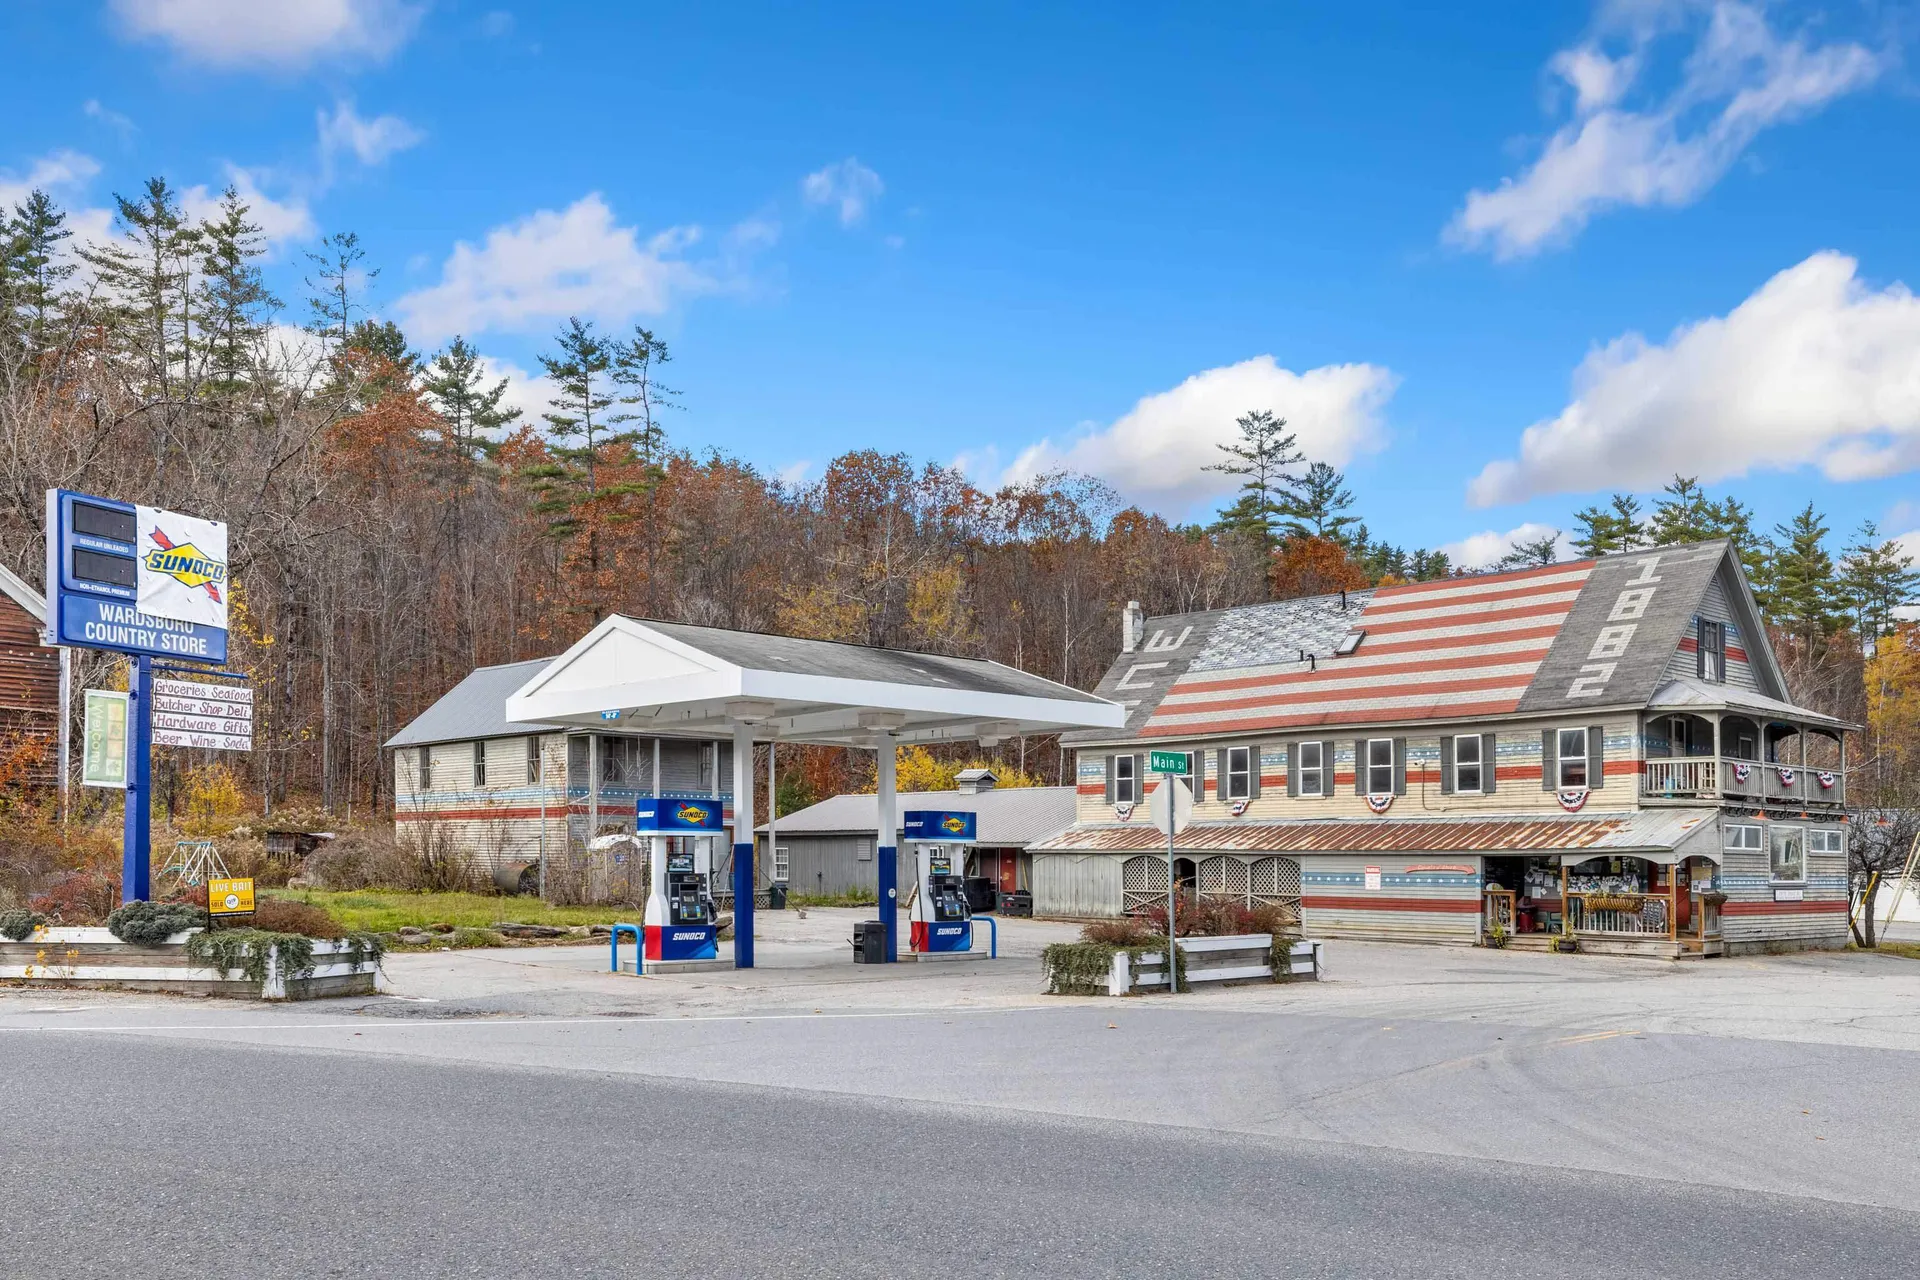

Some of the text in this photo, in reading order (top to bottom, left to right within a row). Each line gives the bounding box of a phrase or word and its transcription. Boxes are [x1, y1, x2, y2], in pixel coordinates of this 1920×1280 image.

[80, 538, 129, 553] REGULAR UNLEADED
[150, 553, 225, 580] SUNOCO
[79, 582, 111, 594] NON-ETHANOL
[1565, 556, 1662, 699] 1882
[85, 621, 207, 655] COUNTRY STORE
[155, 681, 251, 702] Groceries Seafood
[155, 697, 248, 718] Butcher Shop Deli
[156, 714, 249, 734] Hardware Gifts
[90, 704, 104, 773] Welcome
[154, 731, 249, 750] Beer Wine Soda
[1153, 756, 1175, 769] Main
[211, 881, 252, 893] LIVE BAIT
[211, 900, 224, 908] SOLD
[672, 932, 706, 941] SUNOCO
